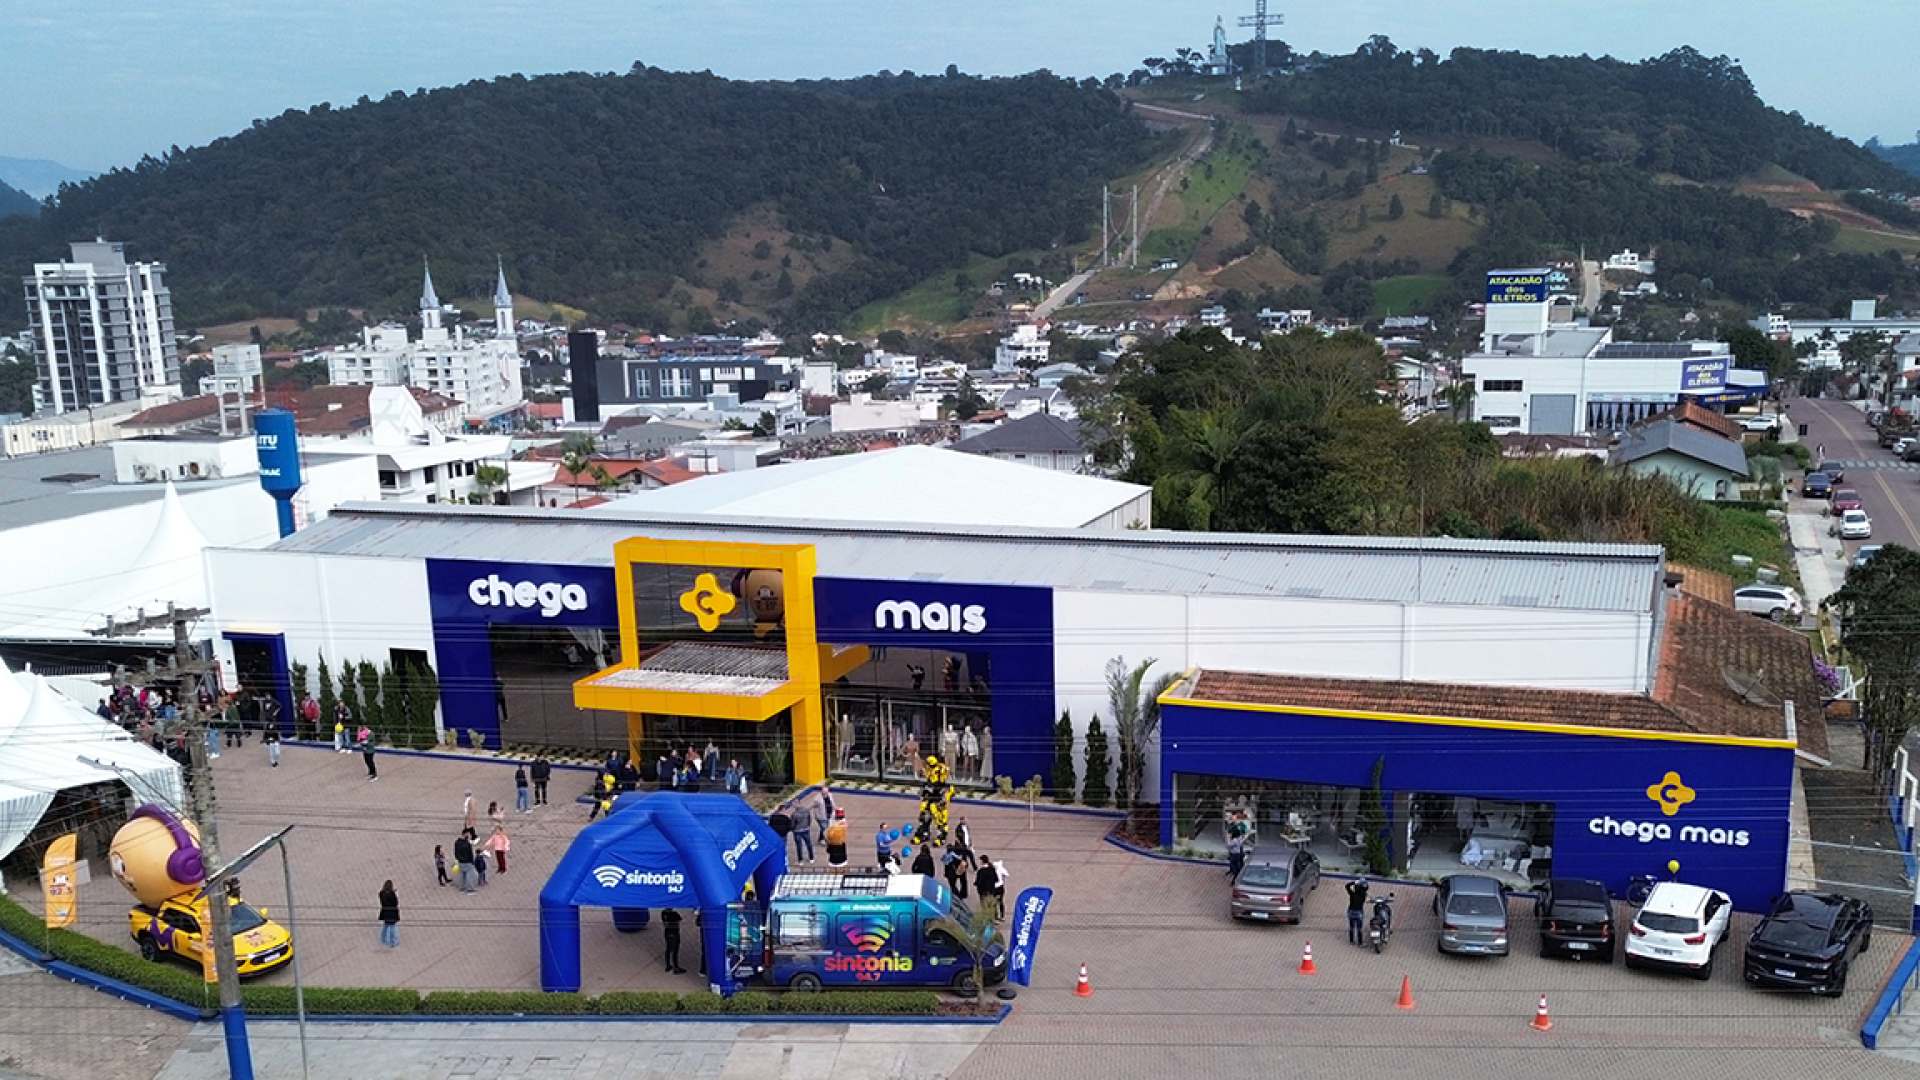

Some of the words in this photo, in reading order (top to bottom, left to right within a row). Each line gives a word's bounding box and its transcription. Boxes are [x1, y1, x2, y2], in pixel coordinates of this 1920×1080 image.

[1489, 275, 1543, 285] ATACADÃO
[1505, 286, 1525, 294] dos
[1491, 294, 1538, 302] ELETROS
[468, 574, 588, 618] chega
[875, 599, 987, 633] mais
[1589, 815, 1671, 843] chega
[1679, 825, 1750, 846] mais
[625, 869, 684, 885] sintonia
[1016, 896, 1039, 946] sintonia
[824, 951, 913, 972] sintonia
